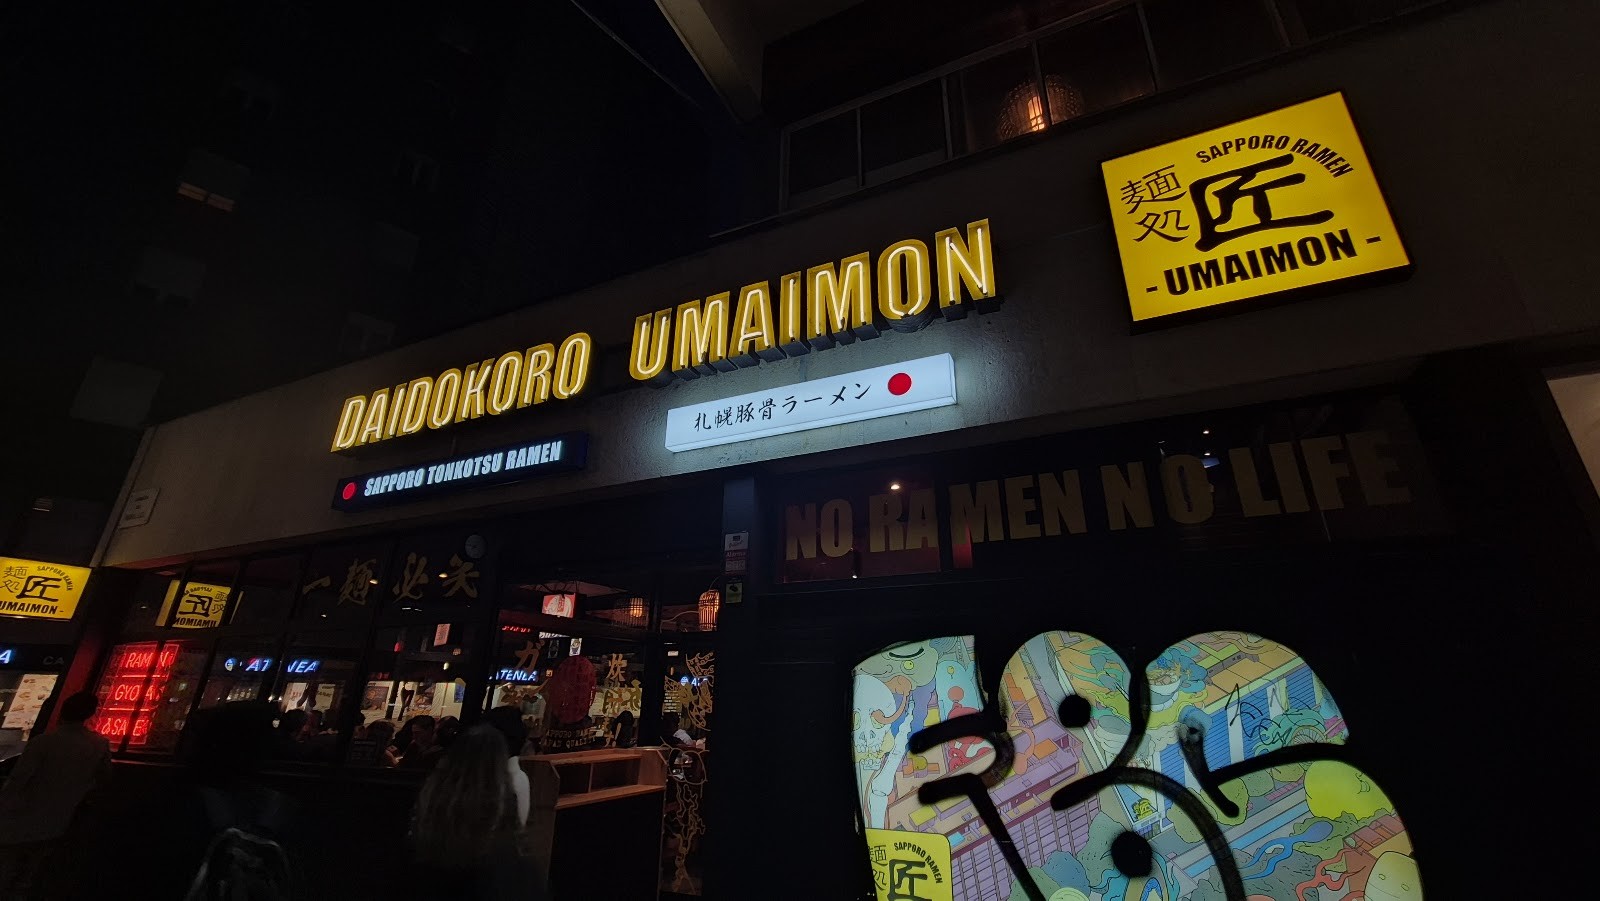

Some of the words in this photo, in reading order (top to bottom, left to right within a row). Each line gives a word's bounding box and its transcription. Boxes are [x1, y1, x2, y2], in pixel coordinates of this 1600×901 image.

[1196, 134, 1290, 164] SAPPORO
[1289, 137, 1355, 179] RAMEN
[1188, 153, 1335, 253] 匠
[1163, 228, 1358, 296] UMAIMON
[331, 332, 591, 452] DAIDOKORO
[629, 218, 996, 380] UMAIMON
[693, 383, 872, 432] 札幌豚骨ラーメン
[363, 468, 426, 497] SAPPORO
[427, 452, 504, 485] TONKOTSU
[505, 440, 563, 471] RAMEN
[785, 499, 854, 560] NO
[1099, 452, 1215, 532] NO
[1228, 429, 1413, 519] LIFE
[893, 842, 927, 859] SAPPORO
[924, 855, 944, 884] RAMEN
